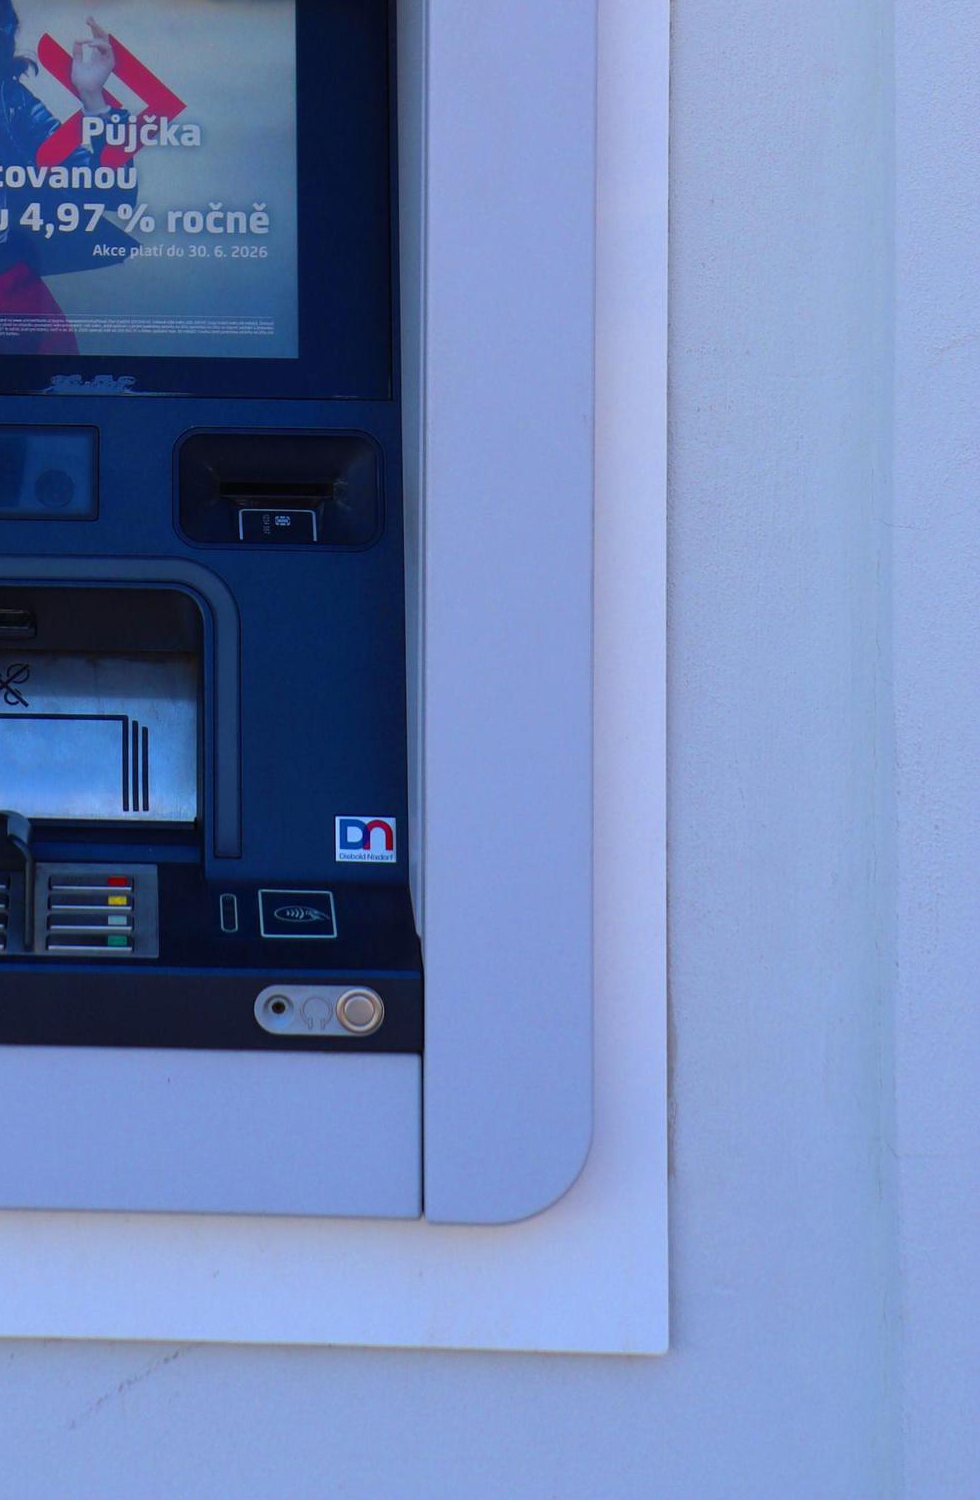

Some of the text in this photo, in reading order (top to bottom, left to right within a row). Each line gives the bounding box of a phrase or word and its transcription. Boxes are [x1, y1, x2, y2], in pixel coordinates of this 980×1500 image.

[81, 114, 202, 153] Půjčka
[19, 203, 105, 239] 4,97
[116, 204, 156, 234] %
[166, 202, 271, 235] ročně
[92, 244, 269, 261] Akce platí do 30. 6. 2026
